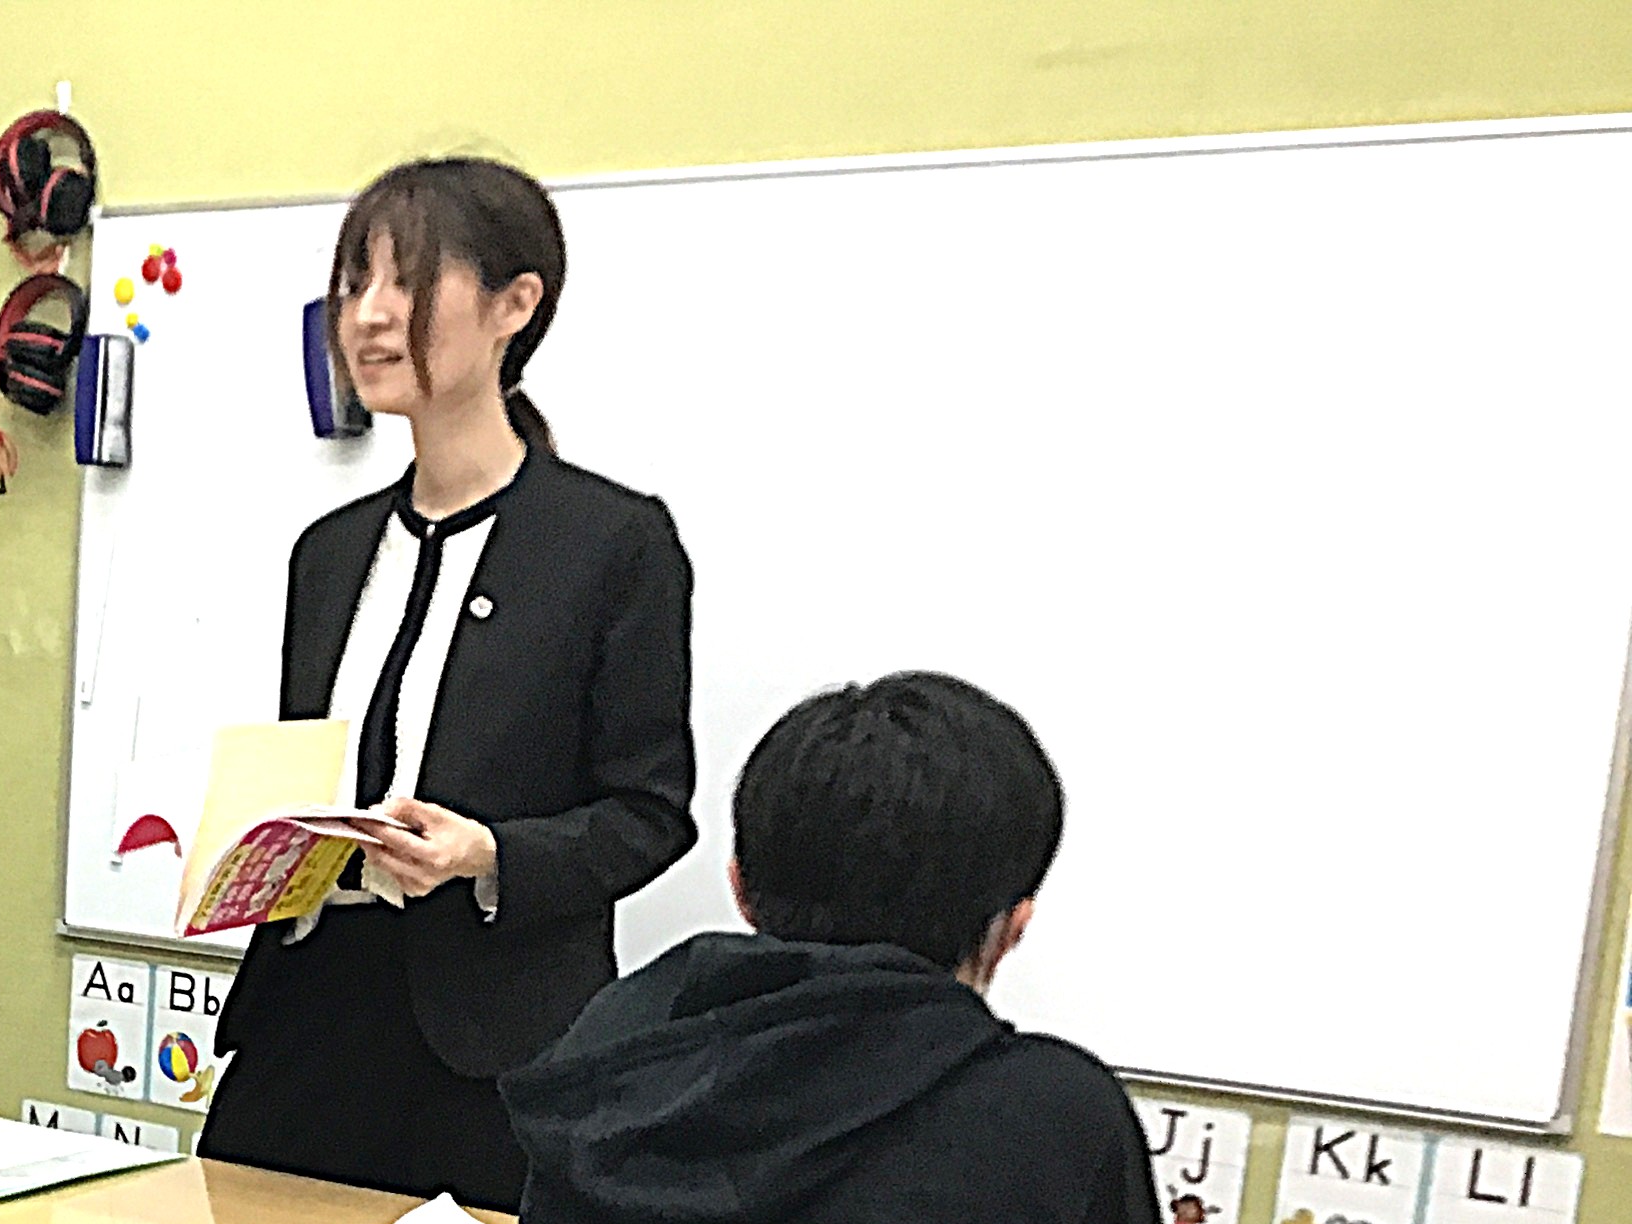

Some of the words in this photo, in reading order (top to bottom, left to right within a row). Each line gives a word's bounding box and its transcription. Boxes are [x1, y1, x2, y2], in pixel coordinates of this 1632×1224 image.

[82, 960, 135, 1004] Aa
[168, 970, 221, 1017] Bb
[1148, 1106, 1215, 1184] Jj
[1309, 1125, 1392, 1186] Kk
